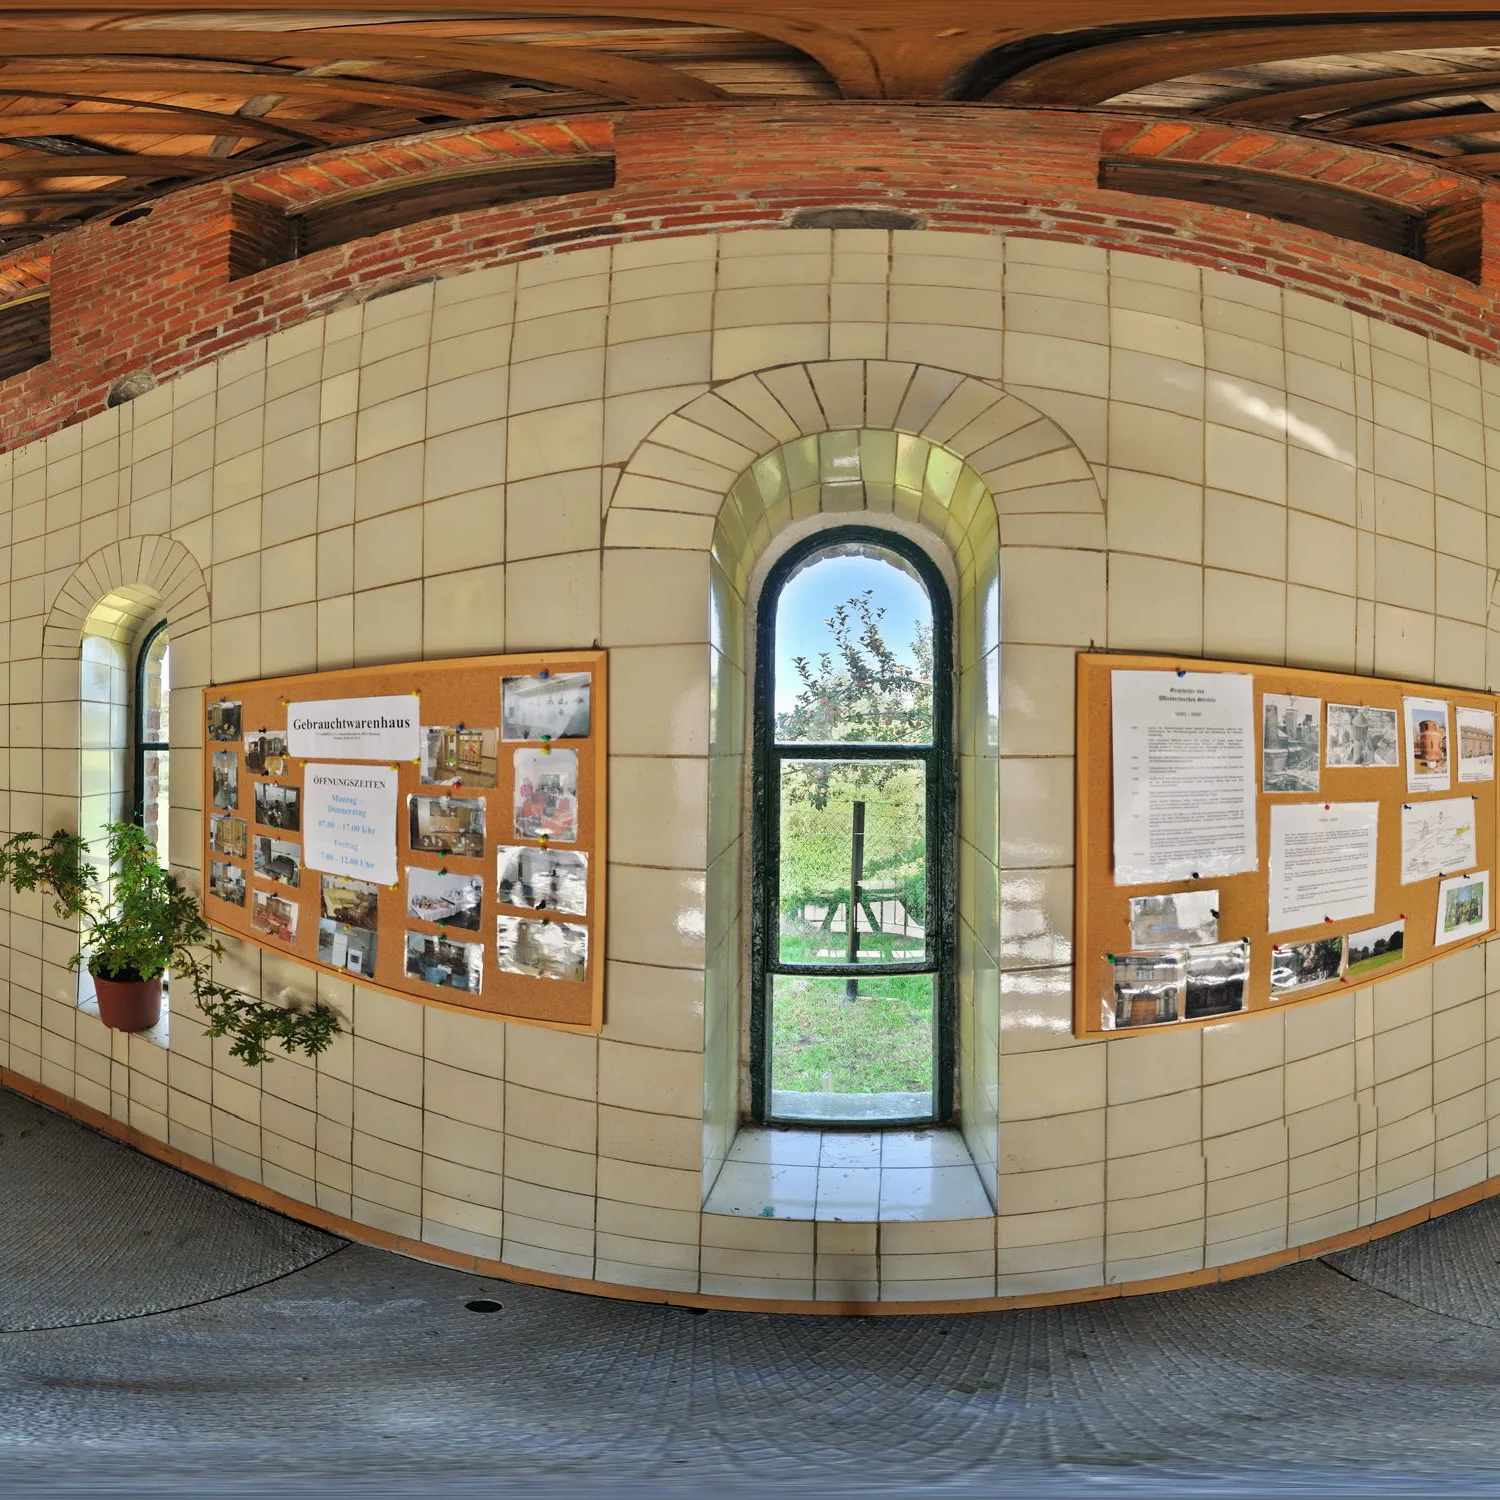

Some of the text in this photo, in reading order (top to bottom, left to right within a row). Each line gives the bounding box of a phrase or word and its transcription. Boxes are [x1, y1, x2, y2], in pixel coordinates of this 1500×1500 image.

[293, 715, 411, 730] Gebrauchtwarenhaus
[313, 775, 387, 789] ÖFFNUNGSZEITEN
[331, 793, 357, 805] Montag
[327, 805, 366, 818] Donnerstag
[361, 825, 376, 835] Uhr
[333, 840, 358, 851] Freitag
